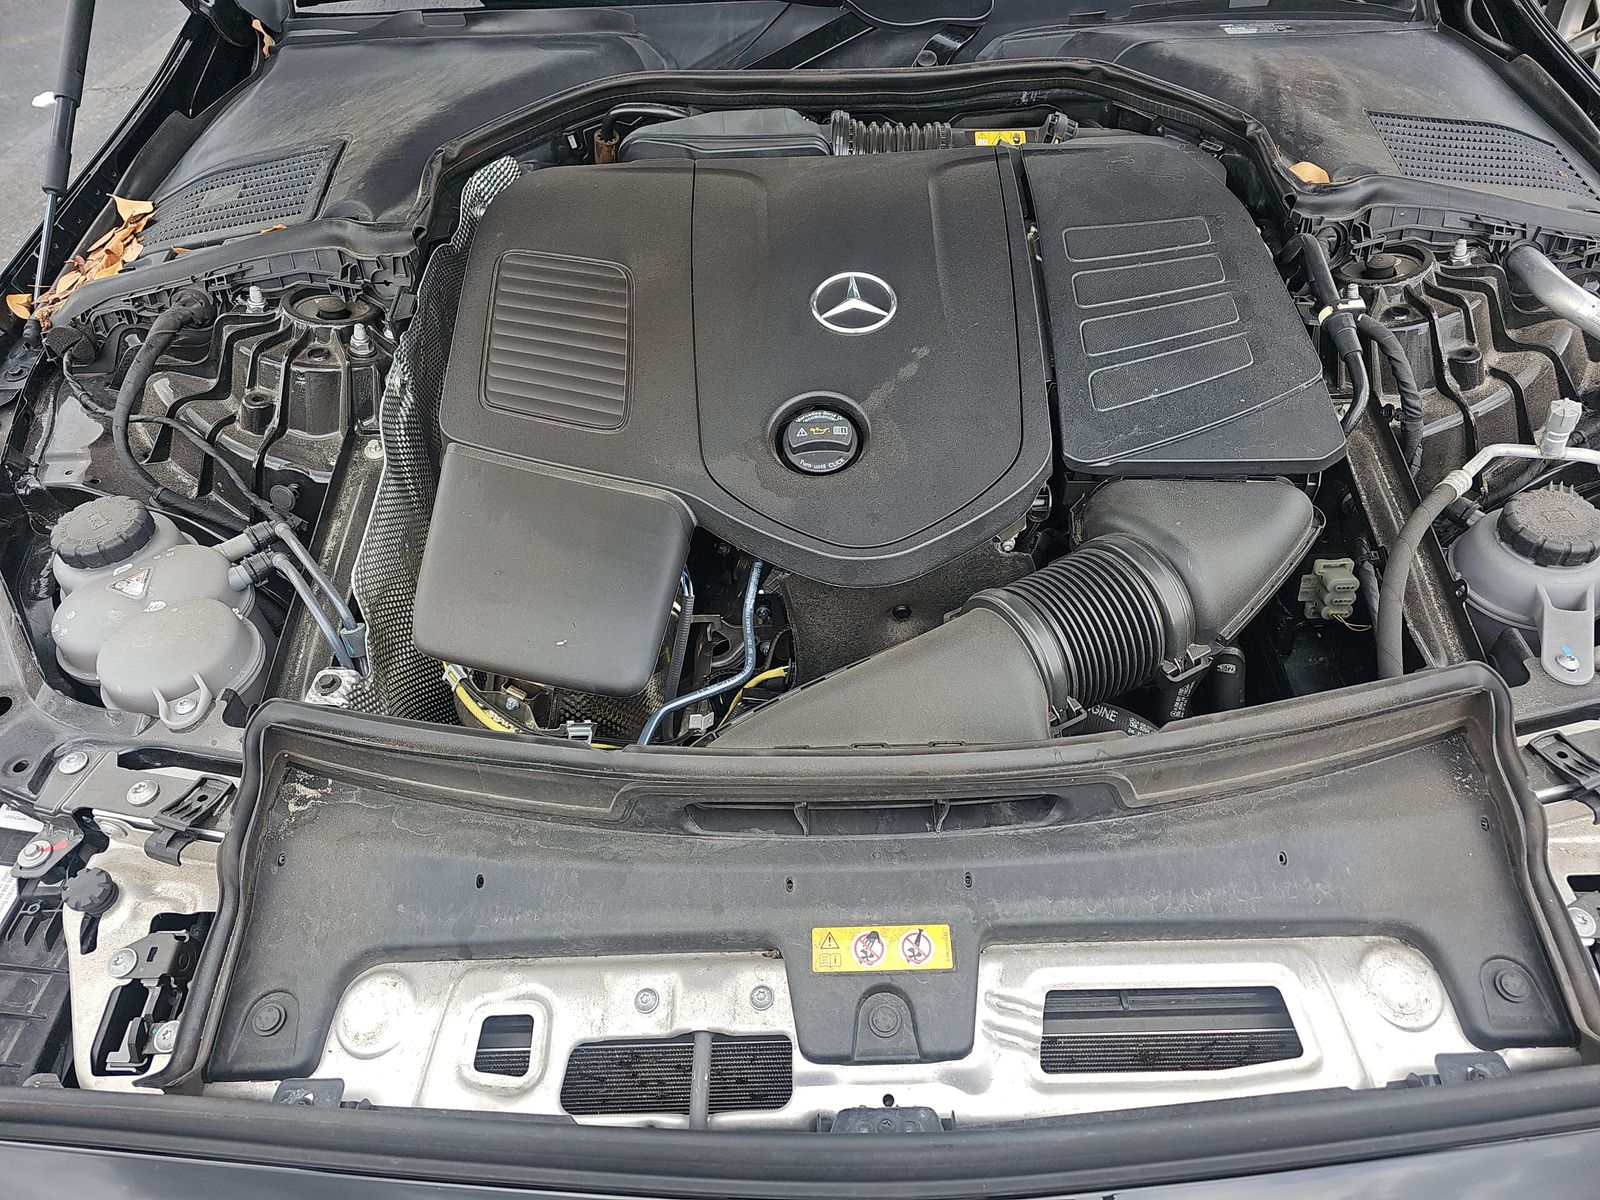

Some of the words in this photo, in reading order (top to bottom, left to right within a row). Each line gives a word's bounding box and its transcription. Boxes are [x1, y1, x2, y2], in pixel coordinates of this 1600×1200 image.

[799, 458, 812, 469] Turn
[828, 457, 845, 469] CLICK
[1088, 704, 1119, 723] GINE
